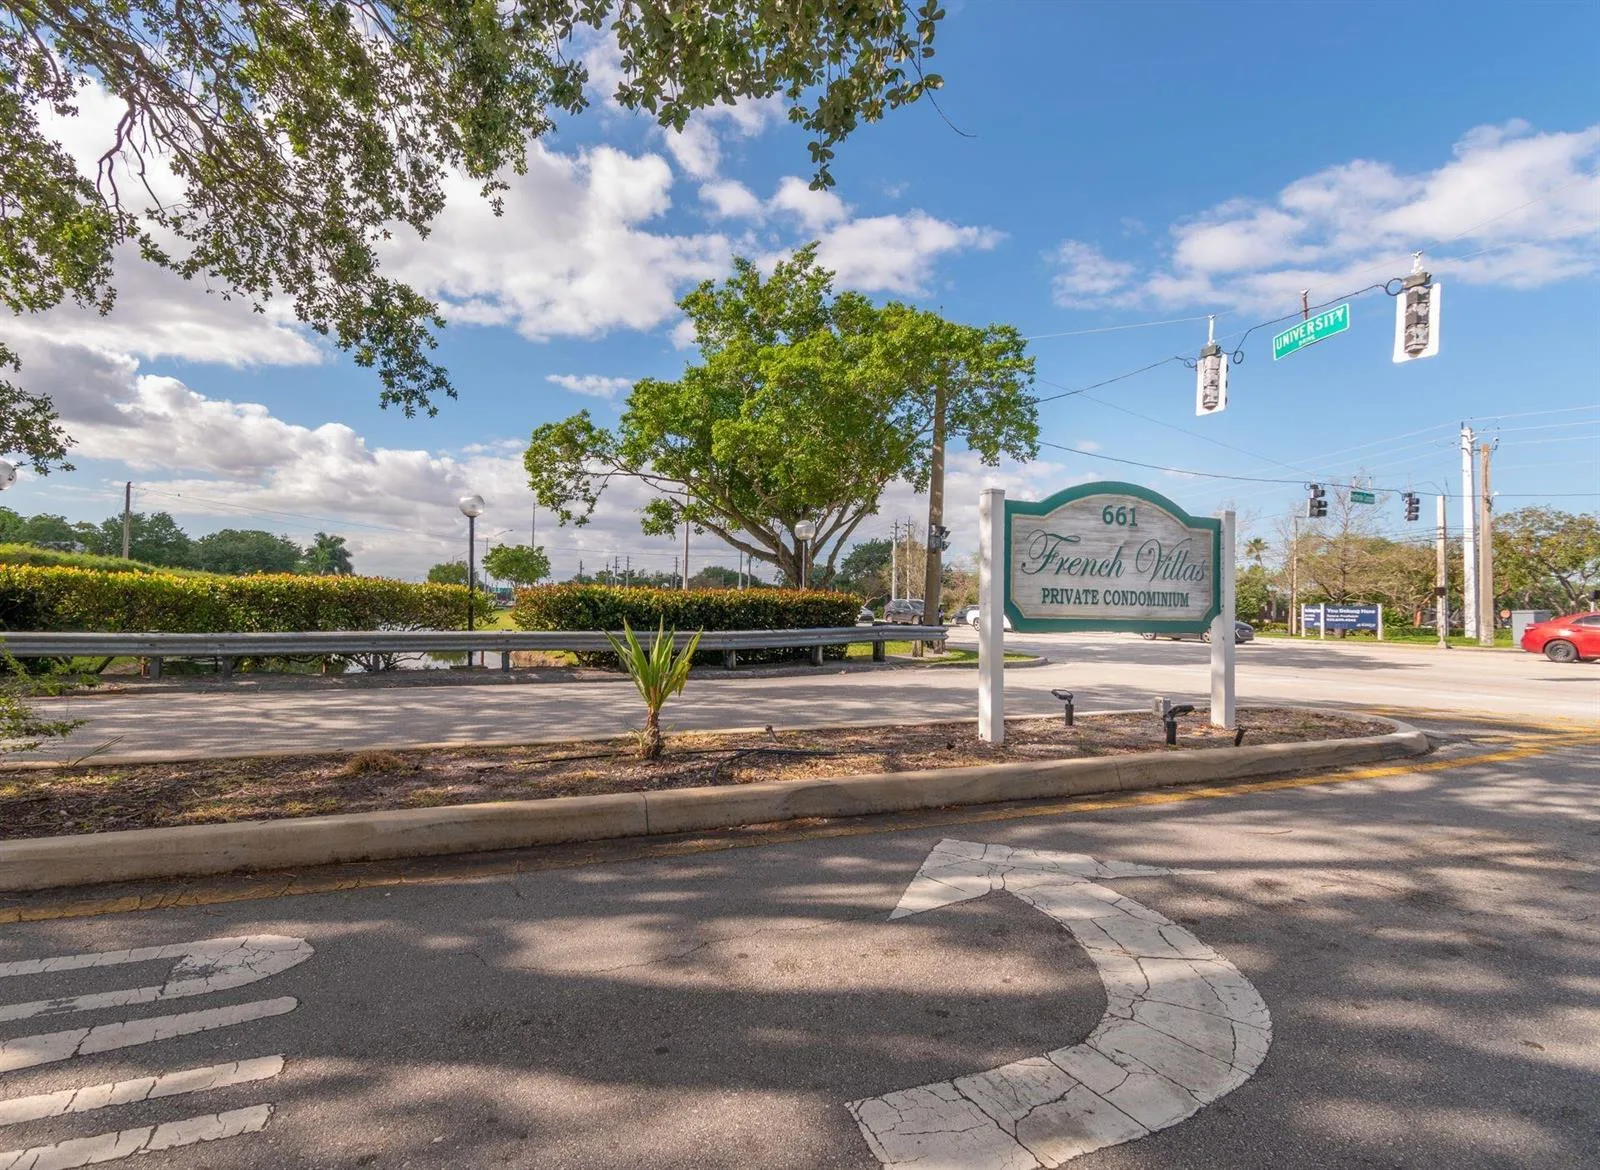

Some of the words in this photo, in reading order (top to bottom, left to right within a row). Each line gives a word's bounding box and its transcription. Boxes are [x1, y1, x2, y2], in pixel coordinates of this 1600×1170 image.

[1275, 307, 1345, 350] UNIVERSITY
[1102, 505, 1138, 527] 661
[1021, 529, 1126, 578] French
[1135, 538, 1207, 583] Villas
[1041, 587, 1099, 606] PRIVATE
[1103, 589, 1190, 608] CONDOMINIUM
